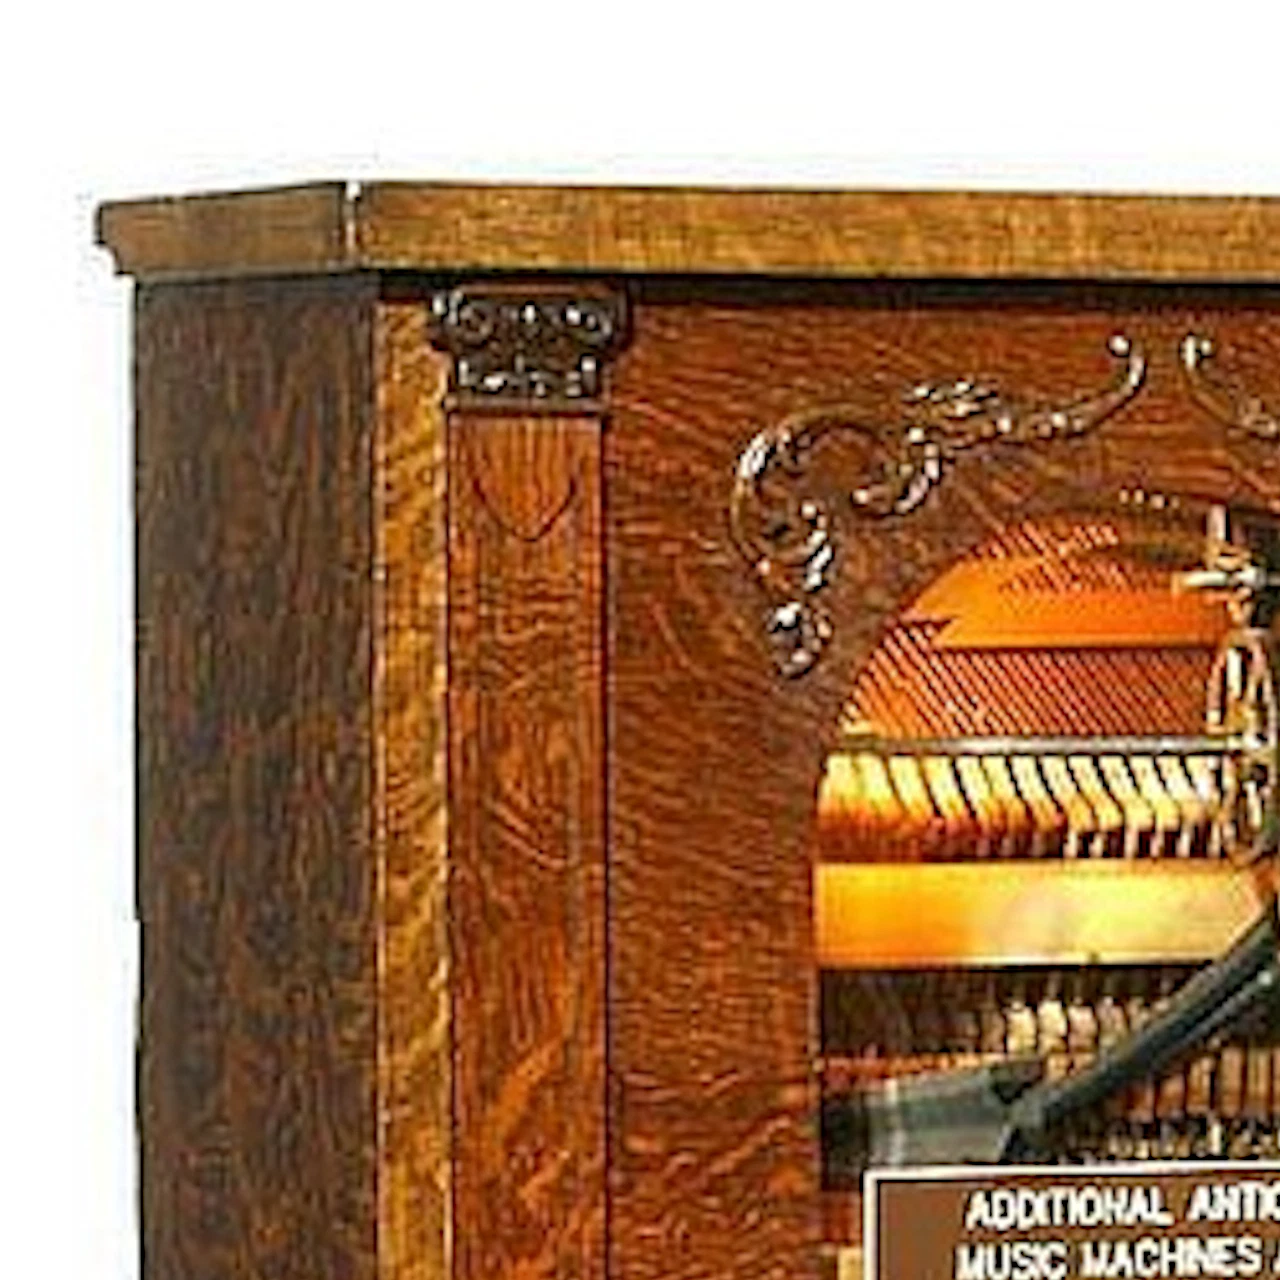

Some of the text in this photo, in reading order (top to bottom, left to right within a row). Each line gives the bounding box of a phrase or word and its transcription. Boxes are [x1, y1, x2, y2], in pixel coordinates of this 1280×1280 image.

[967, 1187, 1172, 1230] ADDITIONAL
[958, 1243, 1066, 1280] MUSIC
[1083, 1237, 1261, 1276] MACHINES
